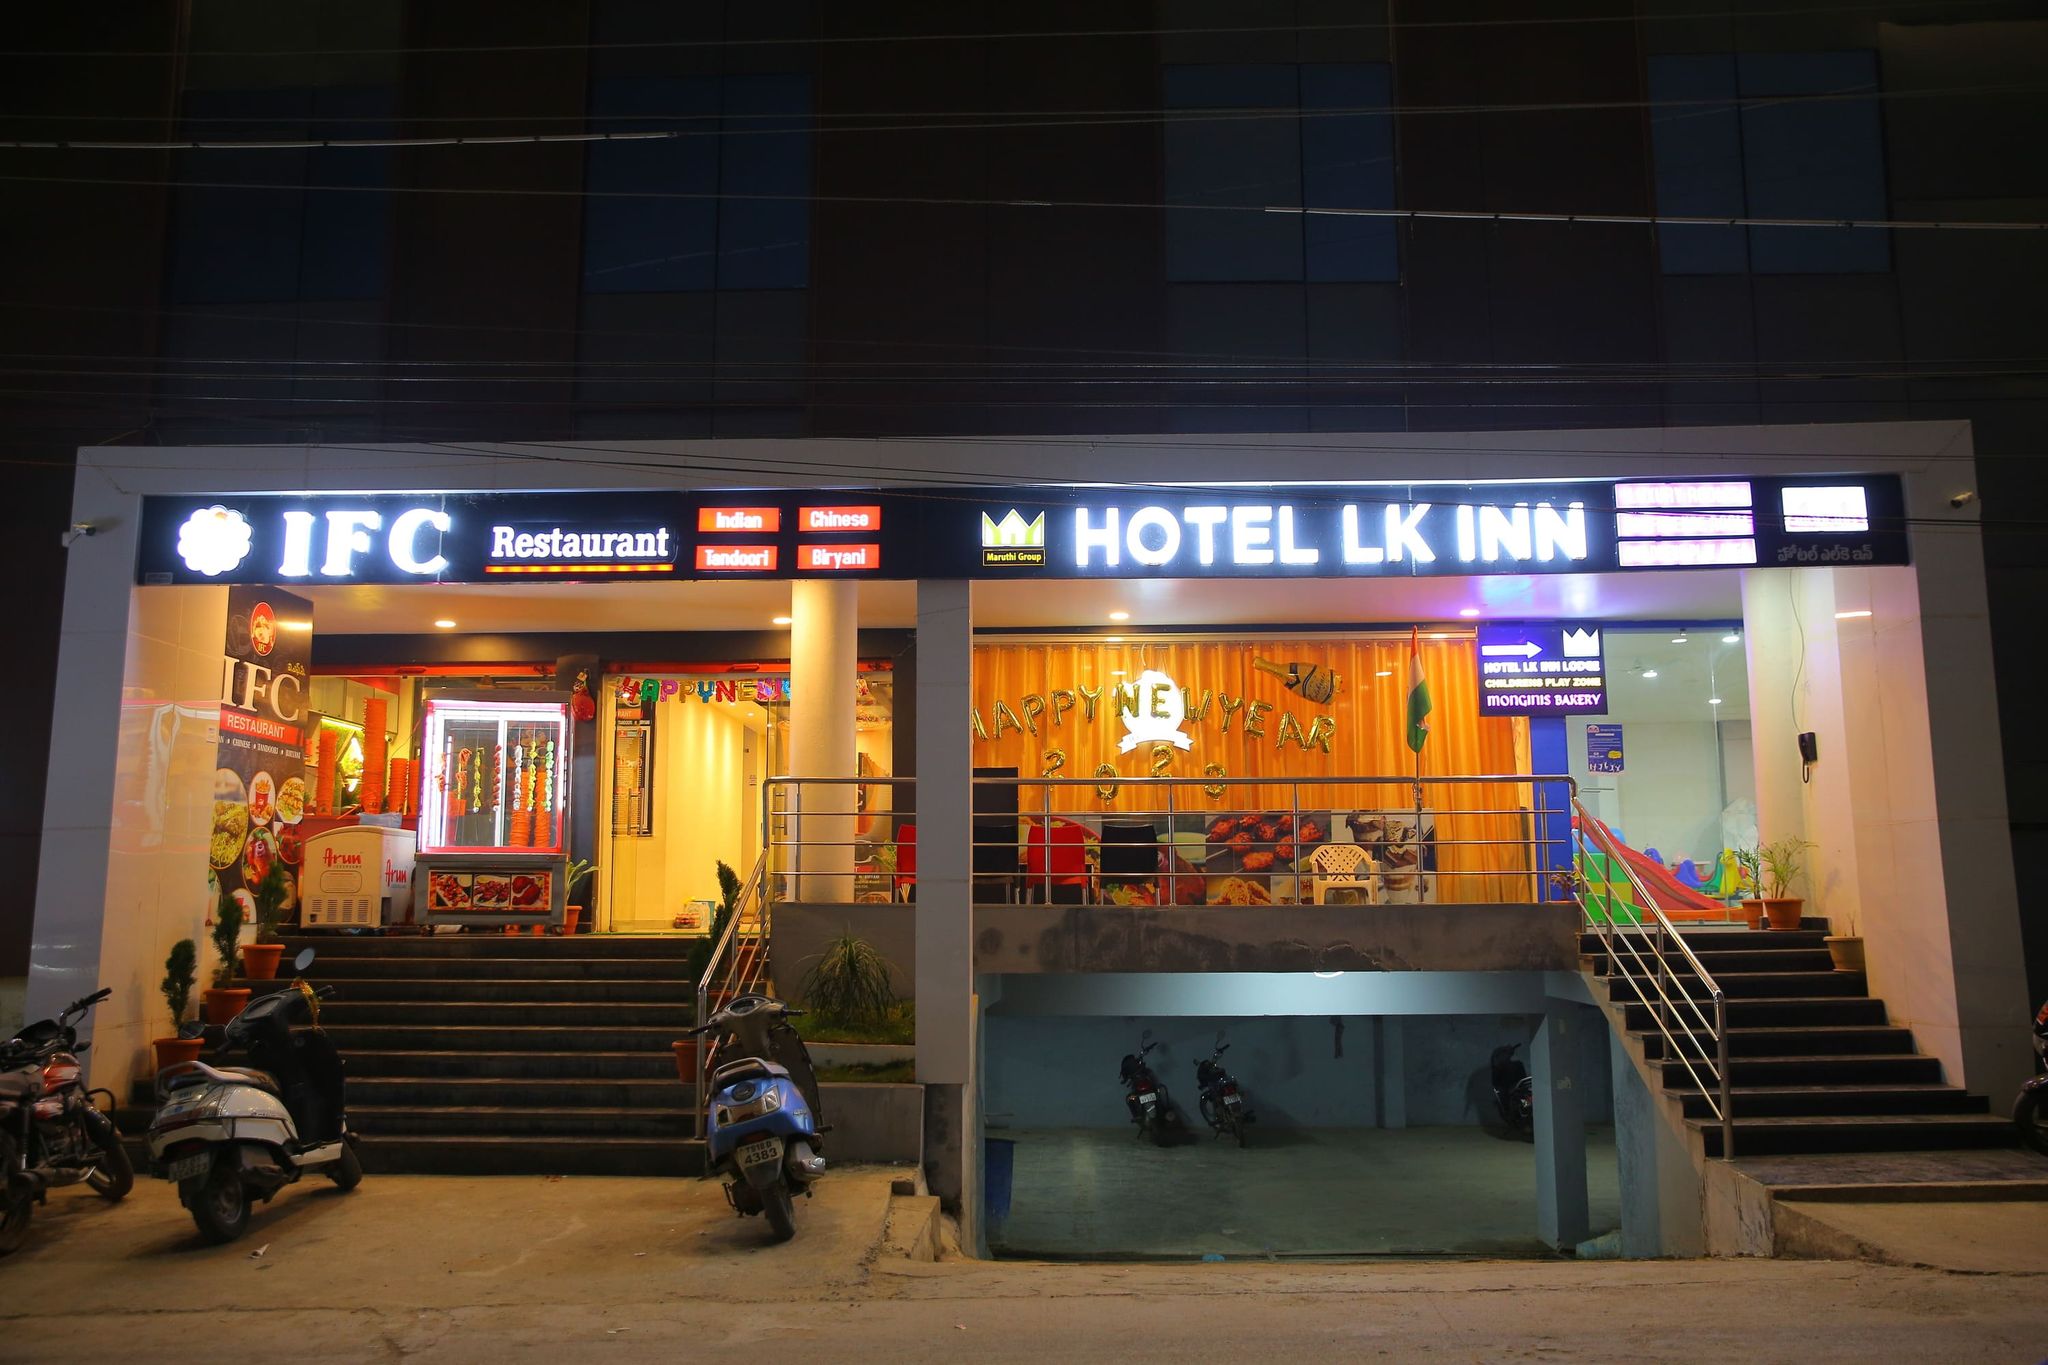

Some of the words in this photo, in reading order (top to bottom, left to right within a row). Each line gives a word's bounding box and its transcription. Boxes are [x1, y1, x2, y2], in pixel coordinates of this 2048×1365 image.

[716, 511, 762, 528] Indian
[810, 510, 868, 527] Chinese
[278, 508, 452, 577] IFC
[492, 522, 670, 559] Restaurant
[1075, 506, 1317, 566] HOTEL
[1343, 502, 1436, 565] LK
[1459, 502, 1588, 562] INN
[704, 549, 768, 566] Tandoori
[812, 548, 866, 569] Biryani
[986, 552, 1016, 562] Maruthi
[1018, 552, 1041, 563] Group
[1484, 661, 1520, 674] HOTEL
[1523, 661, 1538, 673] LK
[1541, 661, 1561, 673] INN
[222, 655, 301, 722] IFC
[1545, 678, 1571, 688] PLAY
[1573, 677, 1601, 687] ZONE
[1554, 693, 1601, 706] BAKERY
[227, 714, 285, 739] RESTAURANT
[323, 847, 362, 867] Arun
[384, 859, 407, 887] Arun
[745, 1147, 777, 1164] 4383
